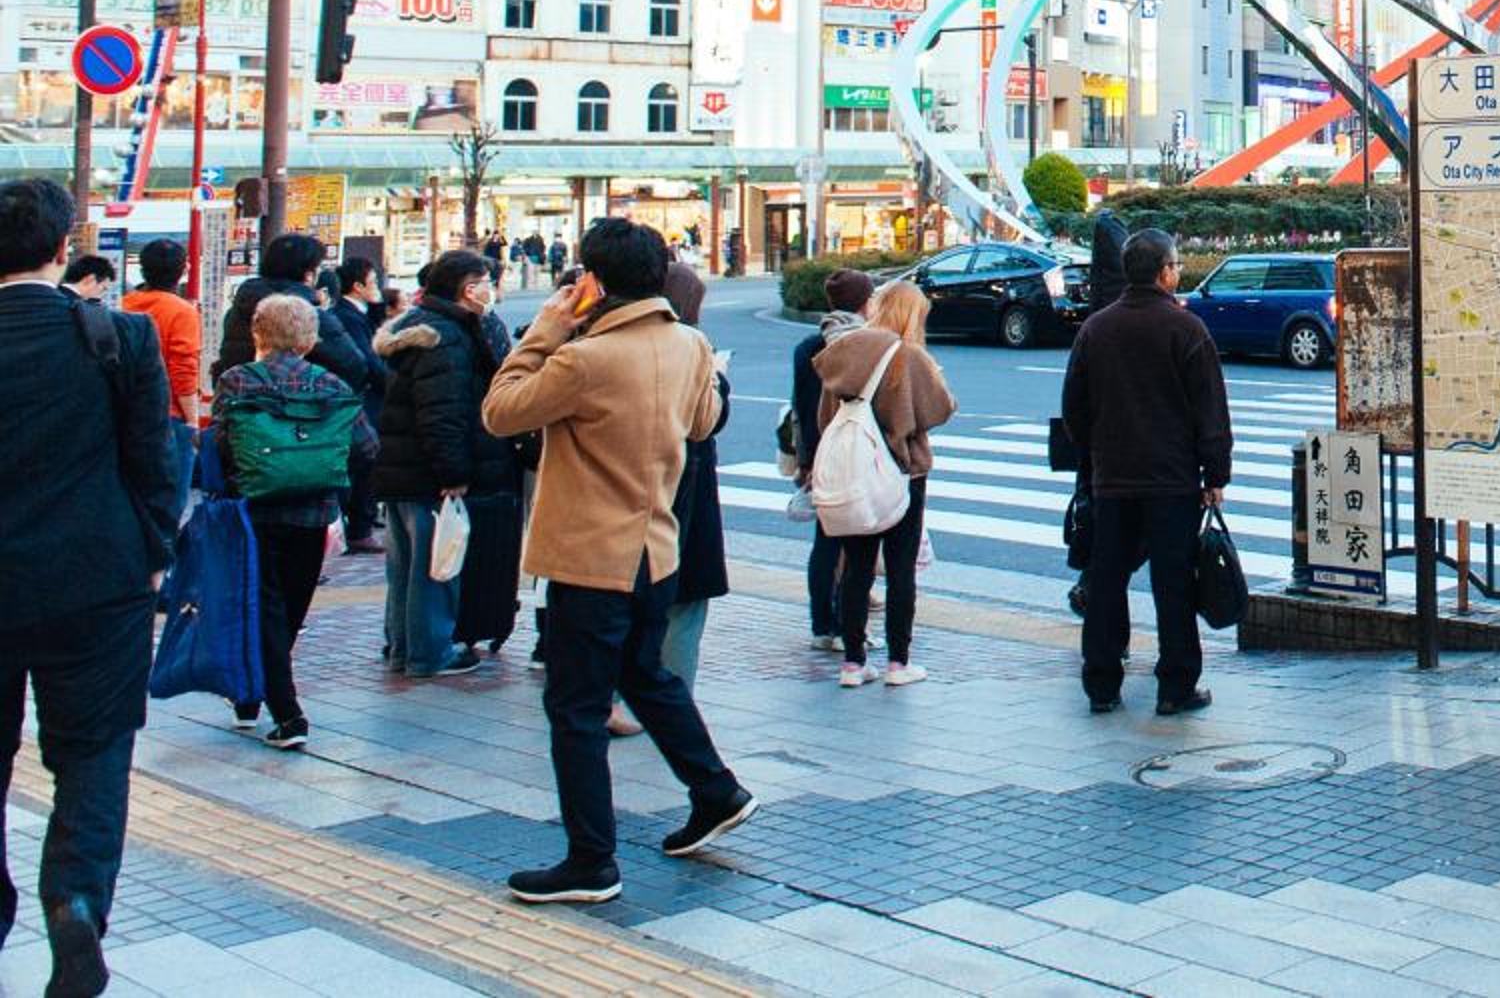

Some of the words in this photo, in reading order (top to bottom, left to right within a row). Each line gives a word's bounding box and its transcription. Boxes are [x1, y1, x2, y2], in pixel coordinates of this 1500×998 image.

[1475, 96, 1497, 110] Ota
[1443, 165, 1461, 180] Ota
[1463, 164, 1484, 182] City
[1343, 445, 1371, 564] 角田家
